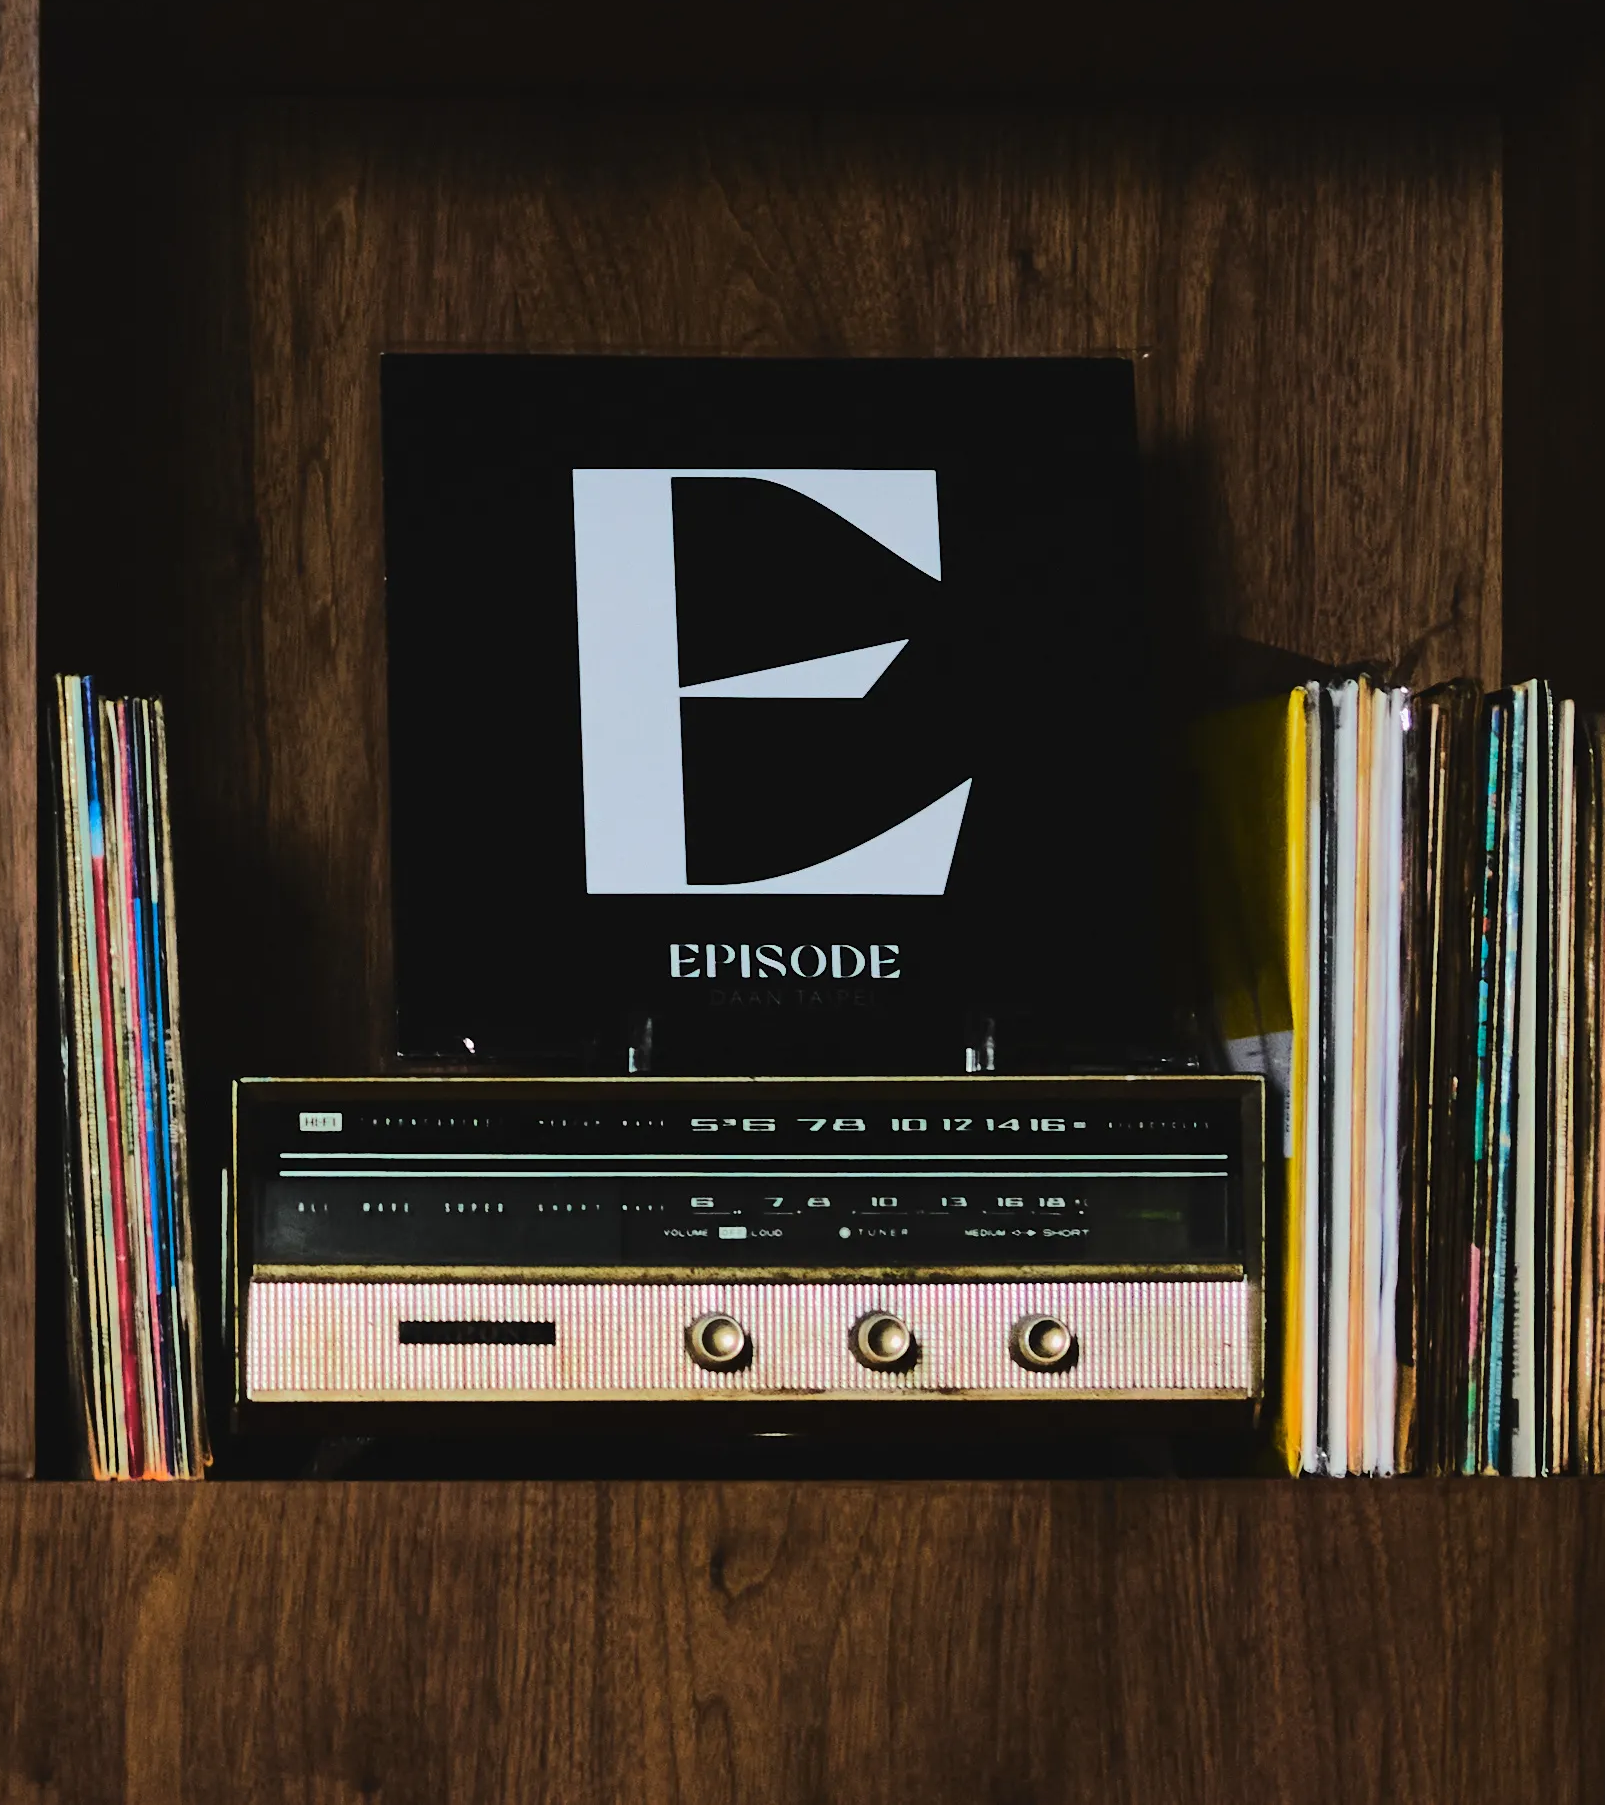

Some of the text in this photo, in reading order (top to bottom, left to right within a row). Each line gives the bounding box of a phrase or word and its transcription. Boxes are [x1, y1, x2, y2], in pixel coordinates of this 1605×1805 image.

[571, 466, 974, 895] E
[669, 942, 901, 979] EPISODE
[891, 1118, 928, 1132] 10
[941, 1118, 973, 1132] 12
[985, 1118, 1021, 1132] 14
[1029, 1118, 1066, 1132] 16
[690, 1196, 715, 1208] 6
[763, 1196, 784, 1208] 7
[806, 1196, 832, 1208] 8
[870, 1196, 899, 1208] 10
[940, 1196, 969, 1208] 13
[996, 1196, 1025, 1208] 16
[1037, 1196, 1067, 1208] 18
[663, 1228, 709, 1238] VOLUME
[750, 1228, 784, 1238] LOUD
[857, 1228, 910, 1237] TUNER
[964, 1228, 1091, 1237] MEDIUM SHORT
